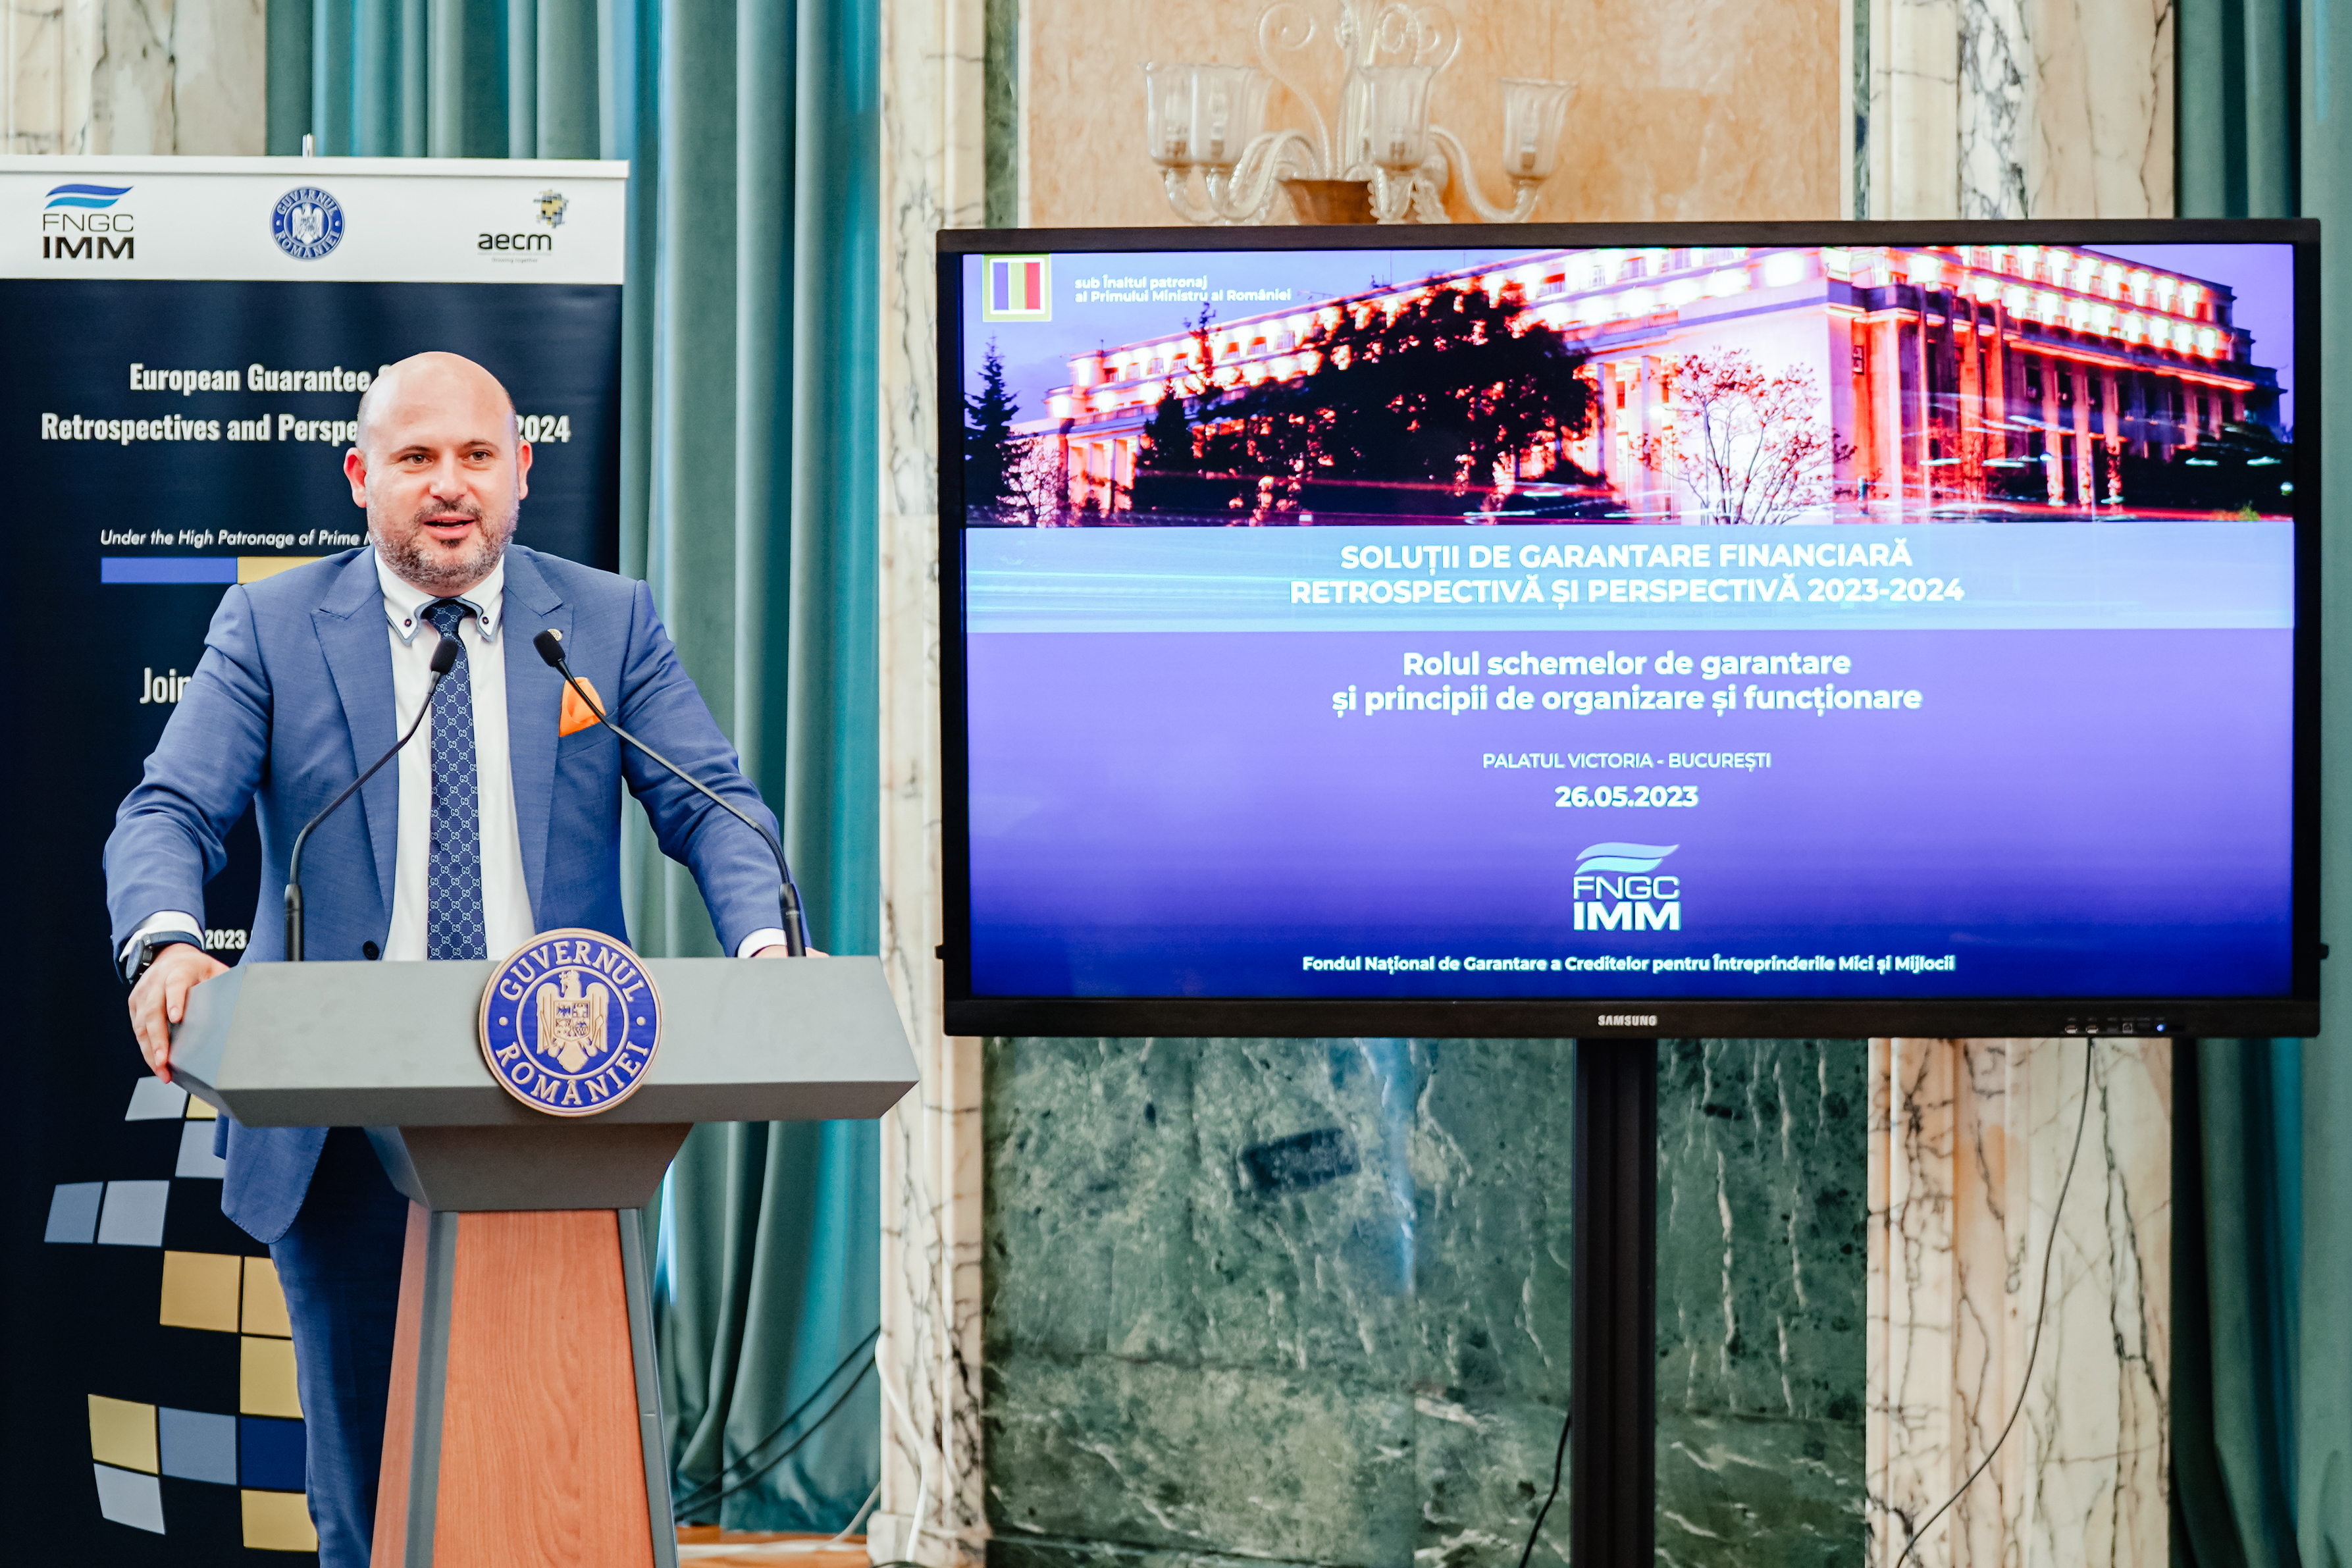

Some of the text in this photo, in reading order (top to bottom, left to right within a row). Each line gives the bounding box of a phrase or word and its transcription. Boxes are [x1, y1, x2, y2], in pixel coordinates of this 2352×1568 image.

[276, 188, 338, 216] GUVERNUL
[43, 213, 134, 232] FNGC
[43, 236, 134, 259] IMM
[477, 233, 552, 251] aecm
[1074, 276, 1101, 289] sub
[1150, 274, 1208, 291] patronaj
[1074, 288, 1292, 303] al Primului Ministru al României
[130, 363, 372, 396] European Guarantee
[41, 413, 221, 446] Retrospectives
[226, 413, 272, 442] and
[100, 529, 147, 546] Under
[150, 529, 174, 546] the
[178, 529, 215, 550] High
[217, 529, 296, 549] Patronage
[298, 529, 317, 546] of
[319, 529, 361, 546] Prime
[1340, 537, 1914, 576] SOLUȚII DE GARANTARE FINANCIARĂ
[1290, 572, 1966, 610] RETROSPECTIVĂ ȘI PERSPECTIVĂ 2023-2024
[1403, 649, 1852, 681] Rolul schemelor de garantare
[1332, 683, 1923, 718] și principii de organizare și funcționare
[1482, 752, 1566, 769] PALATUL
[1567, 752, 1655, 769] VICTORIA
[1668, 752, 1772, 773] BUCUREȘTI
[1554, 785, 1700, 808] 26.05.2023
[1573, 875, 1681, 900] FNGC
[1573, 901, 1682, 931] IMM
[205, 929, 247, 950] 2023
[499, 940, 646, 1003] GUVERNUL
[1303, 953, 1956, 975] Fondul Național de Garantare a Creditelor pentru Întreprinderile Mici și Mijlocii
[1598, 1014, 1658, 1027] SAMSUNG
[495, 1040, 649, 1106] ROMÂNIEI
